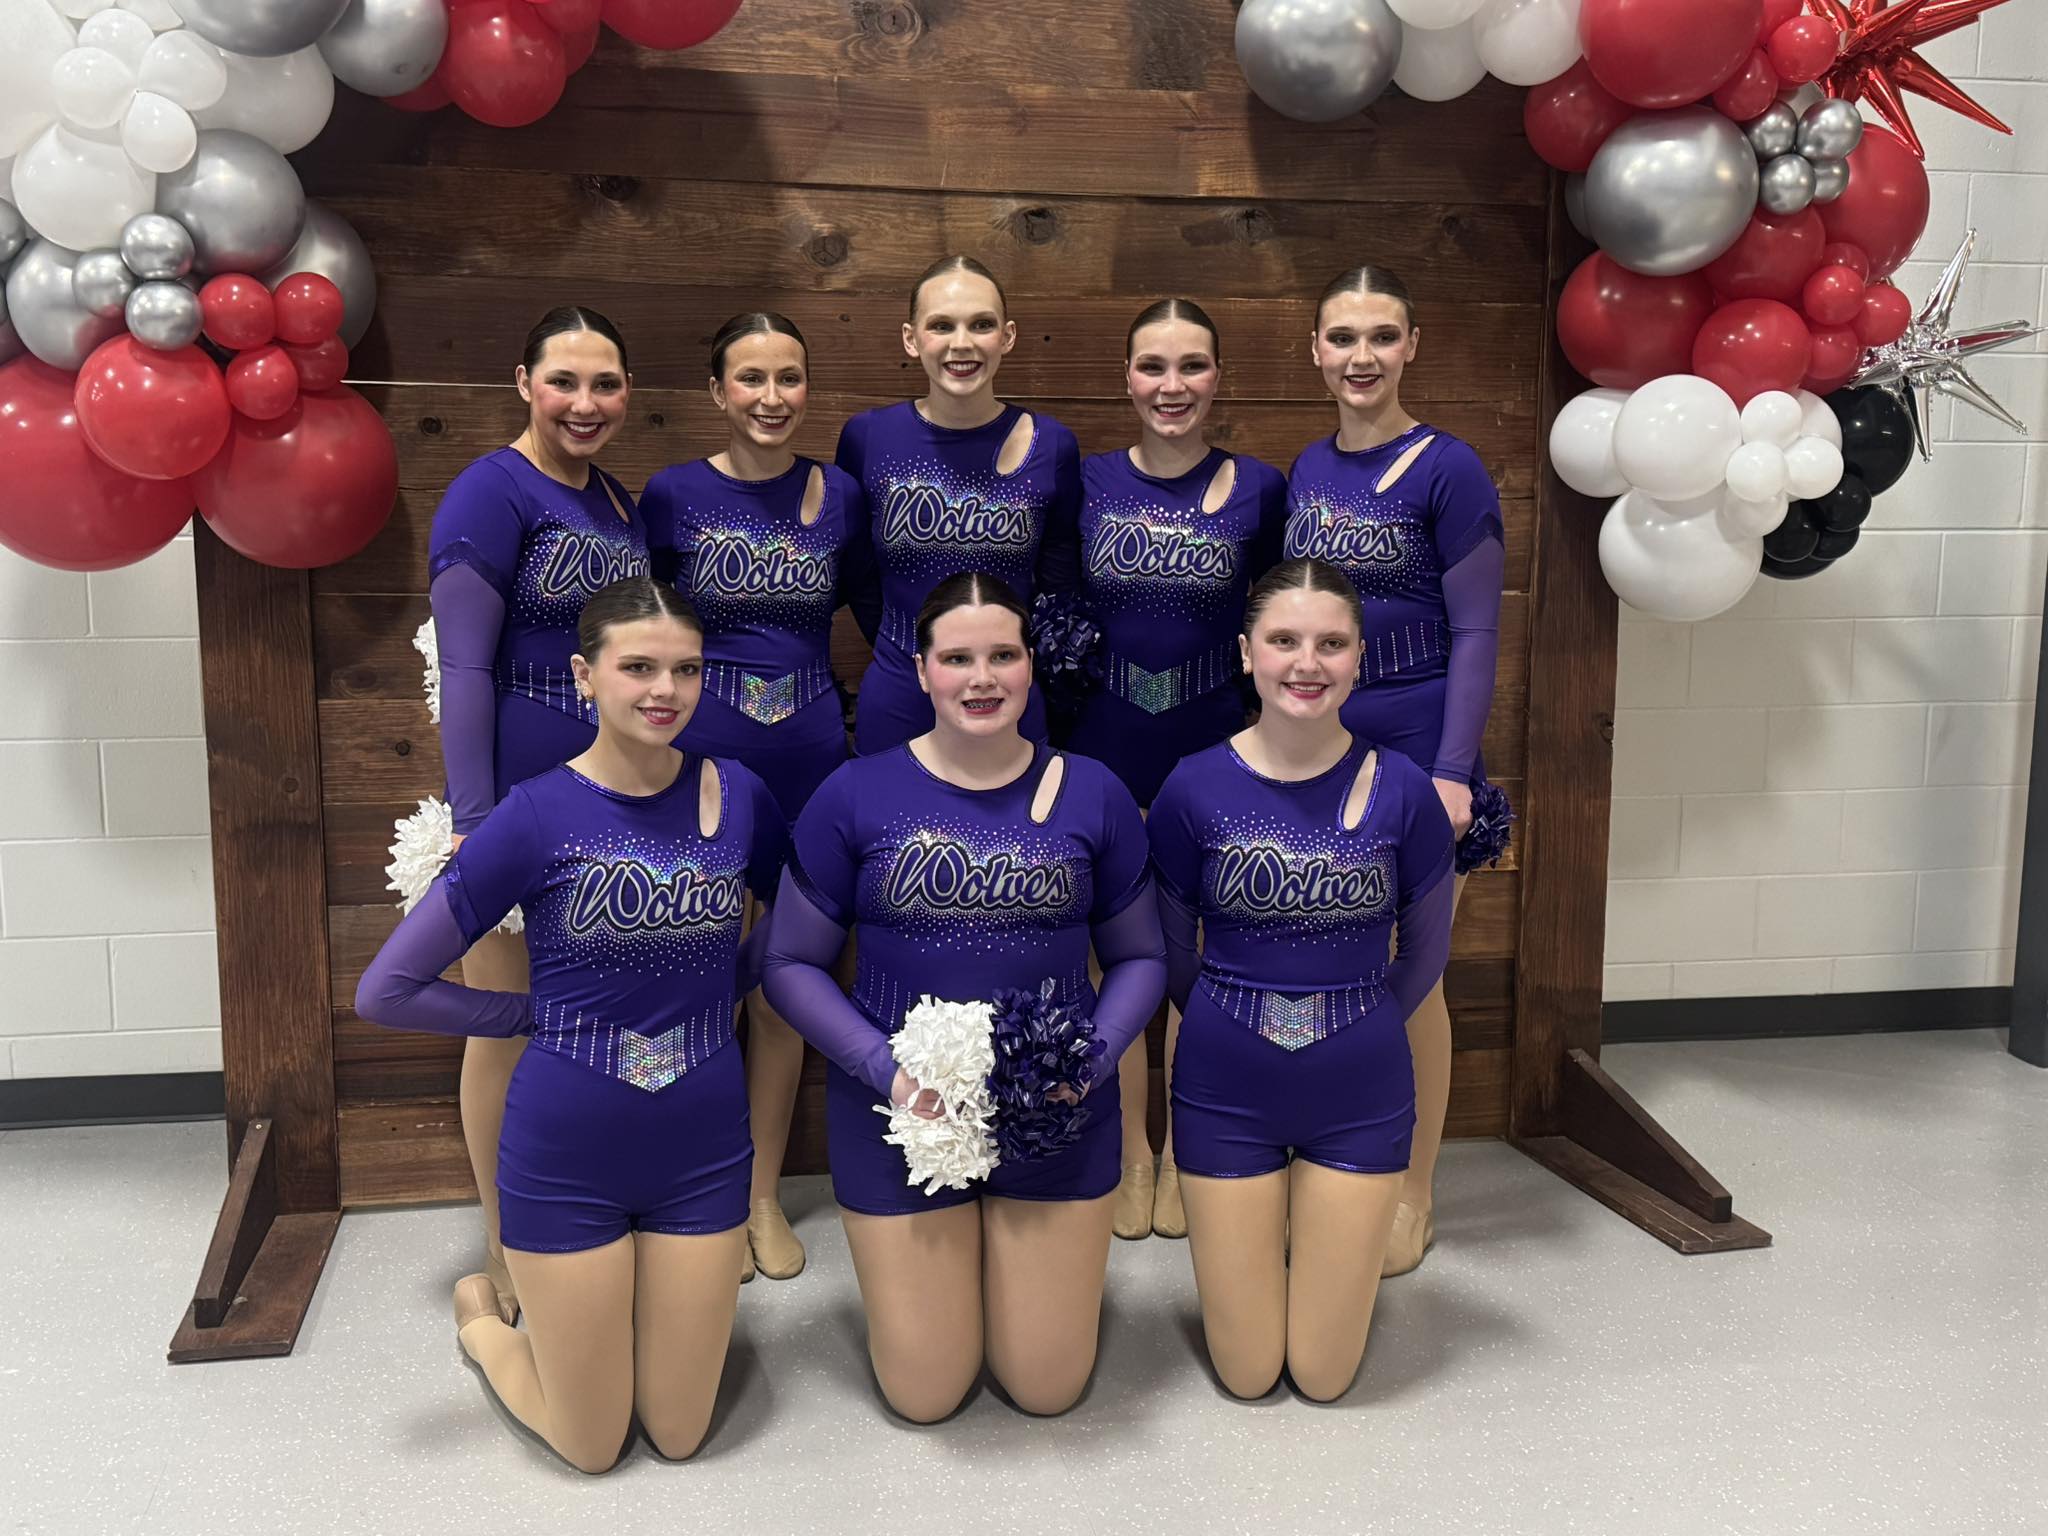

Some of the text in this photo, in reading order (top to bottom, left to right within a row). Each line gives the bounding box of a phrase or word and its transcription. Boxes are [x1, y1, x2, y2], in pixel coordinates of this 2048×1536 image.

[882, 485, 1030, 543] Wolves
[690, 537, 833, 594] Wolves
[1087, 520, 1234, 579] Wolves
[571, 862, 744, 932] Wolves
[889, 842, 1070, 910] Wolves
[1214, 846, 1386, 912] Wolves
